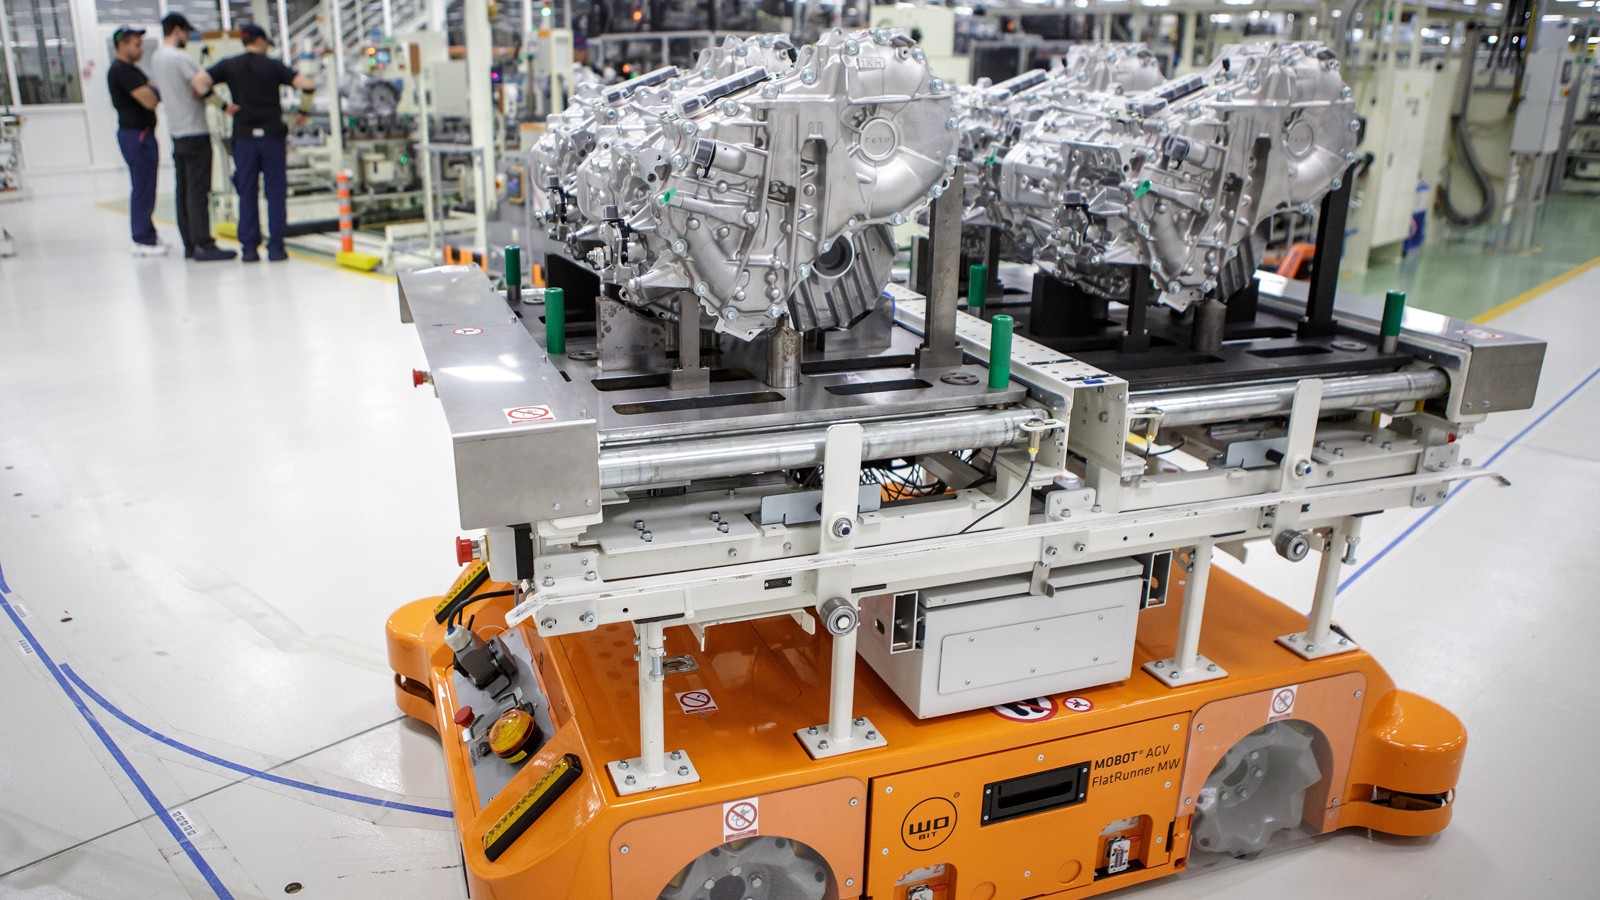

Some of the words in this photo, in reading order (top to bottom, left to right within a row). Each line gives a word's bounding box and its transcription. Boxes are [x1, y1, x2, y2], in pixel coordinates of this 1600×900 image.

[1094, 750, 1138, 771] MOBOT
[1145, 743, 1171, 759] AGV
[1091, 765, 1156, 788] FlatRunner
[1157, 757, 1181, 773] MW
[918, 831, 937, 840] BIT
